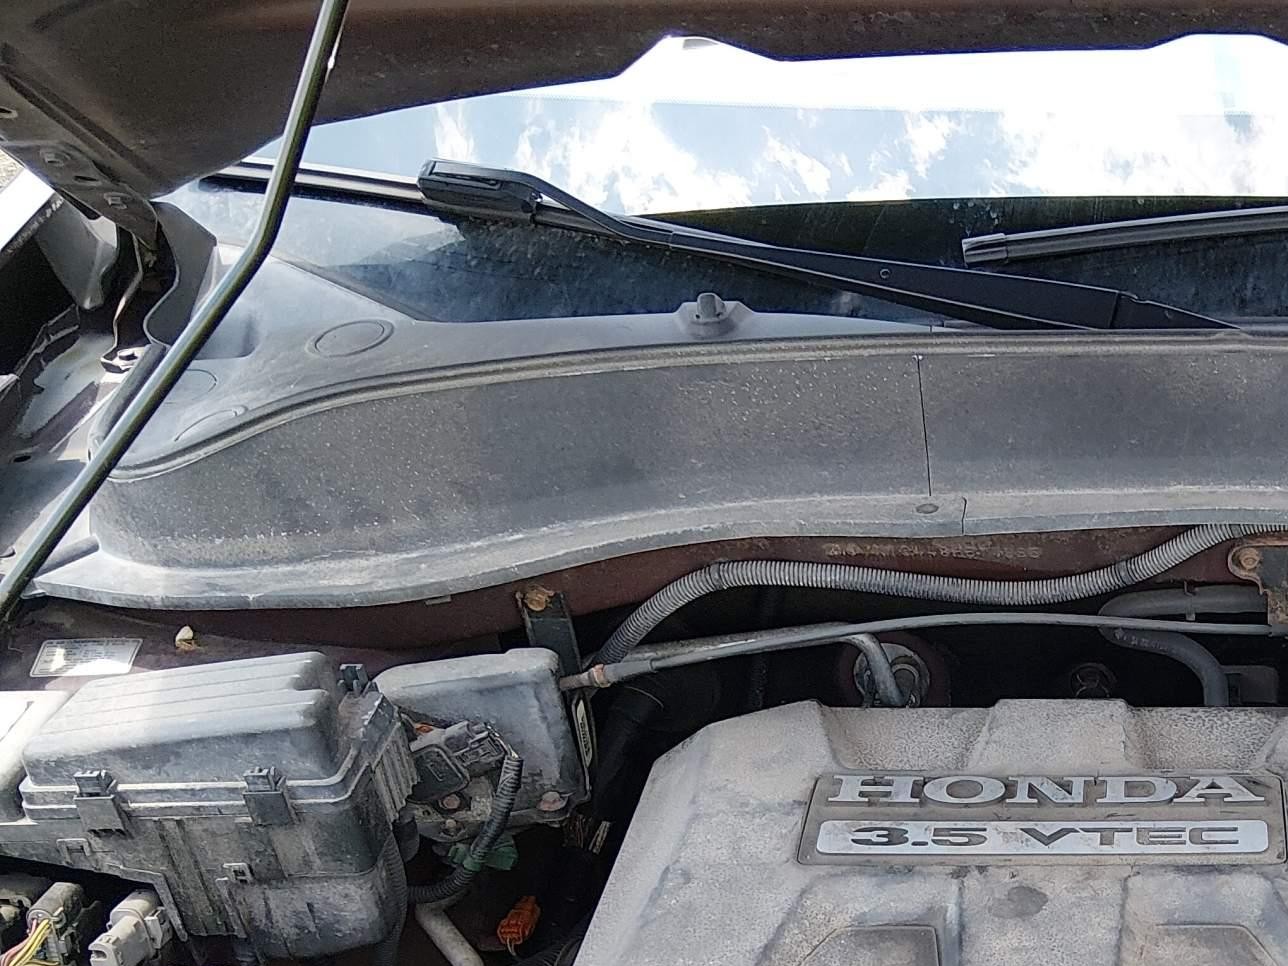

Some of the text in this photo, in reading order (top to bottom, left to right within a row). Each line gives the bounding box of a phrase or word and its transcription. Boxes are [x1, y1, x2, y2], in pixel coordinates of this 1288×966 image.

[828, 775, 1265, 804] HONDA
[850, 826, 1240, 847] 3.5 VTEC
